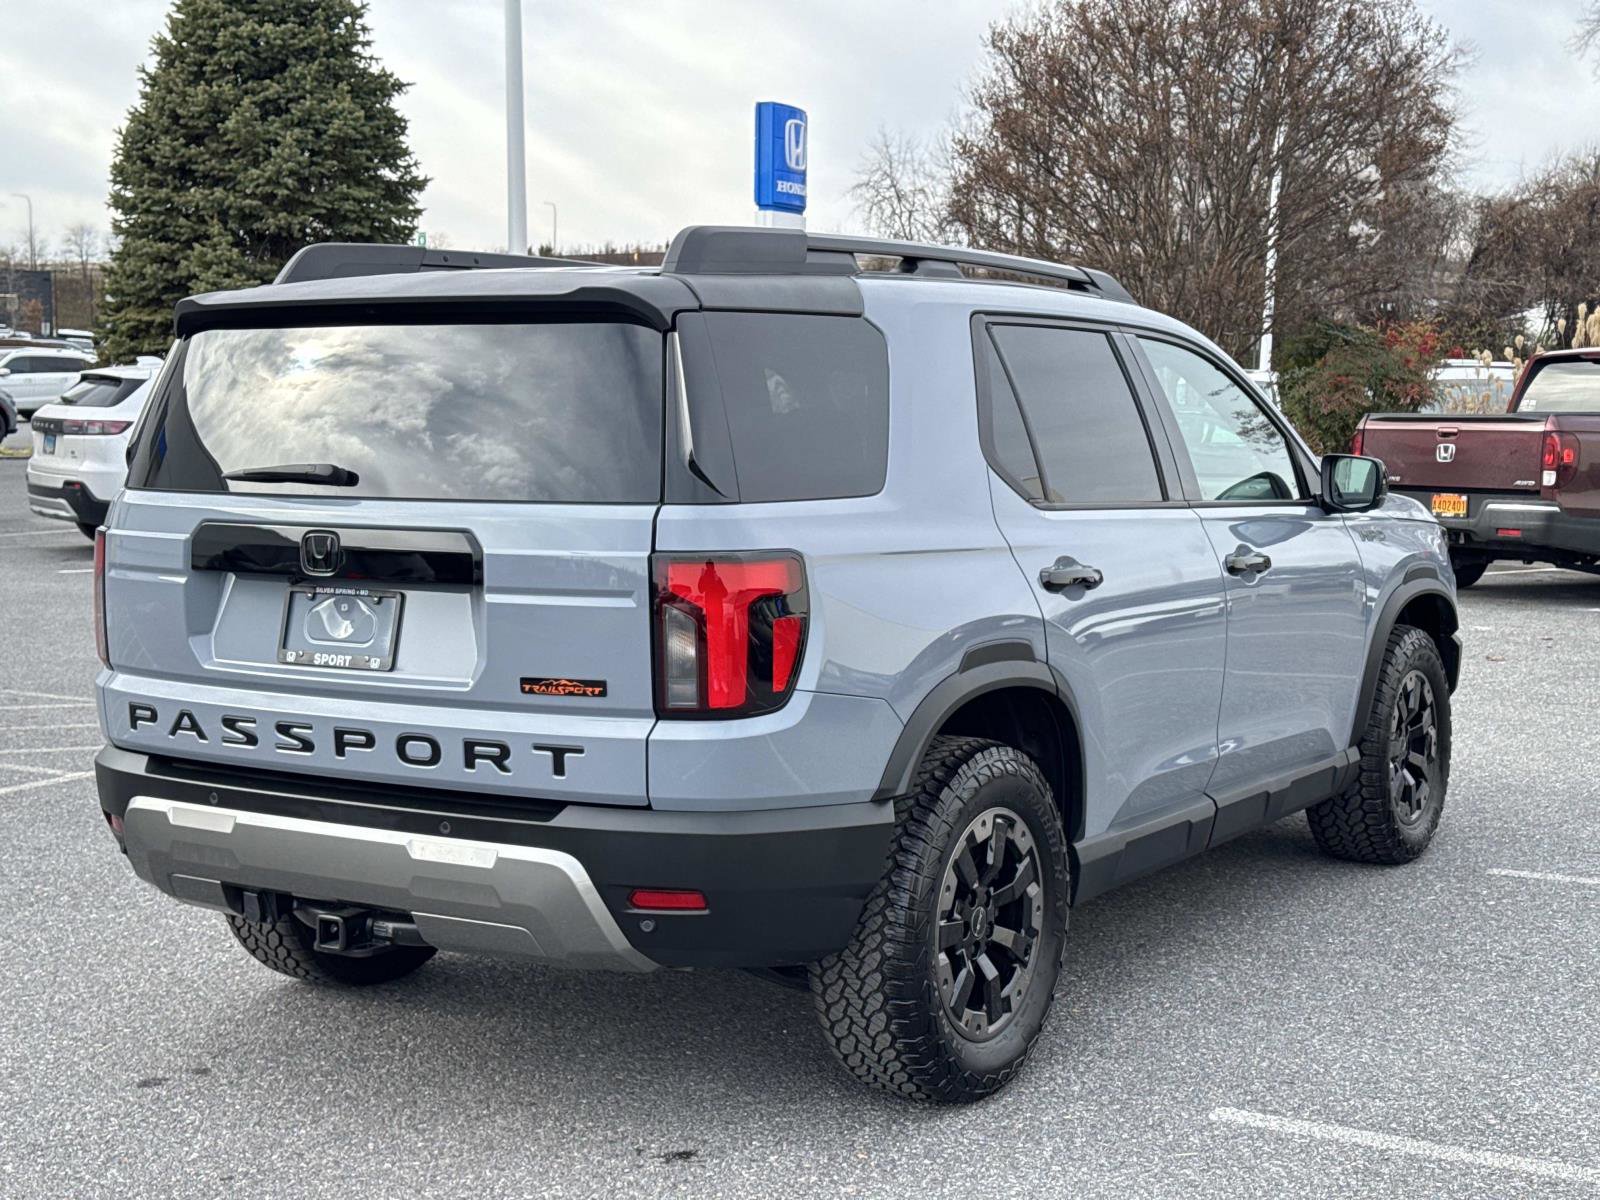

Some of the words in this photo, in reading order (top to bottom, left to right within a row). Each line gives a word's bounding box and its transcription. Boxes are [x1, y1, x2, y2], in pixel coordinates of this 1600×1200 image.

[316, 586, 334, 594] SILVER
[335, 587, 355, 595] SPRING
[313, 653, 352, 667] SPORT
[522, 684, 604, 697] TRAILSPORT
[128, 701, 586, 779] PASSPORT
